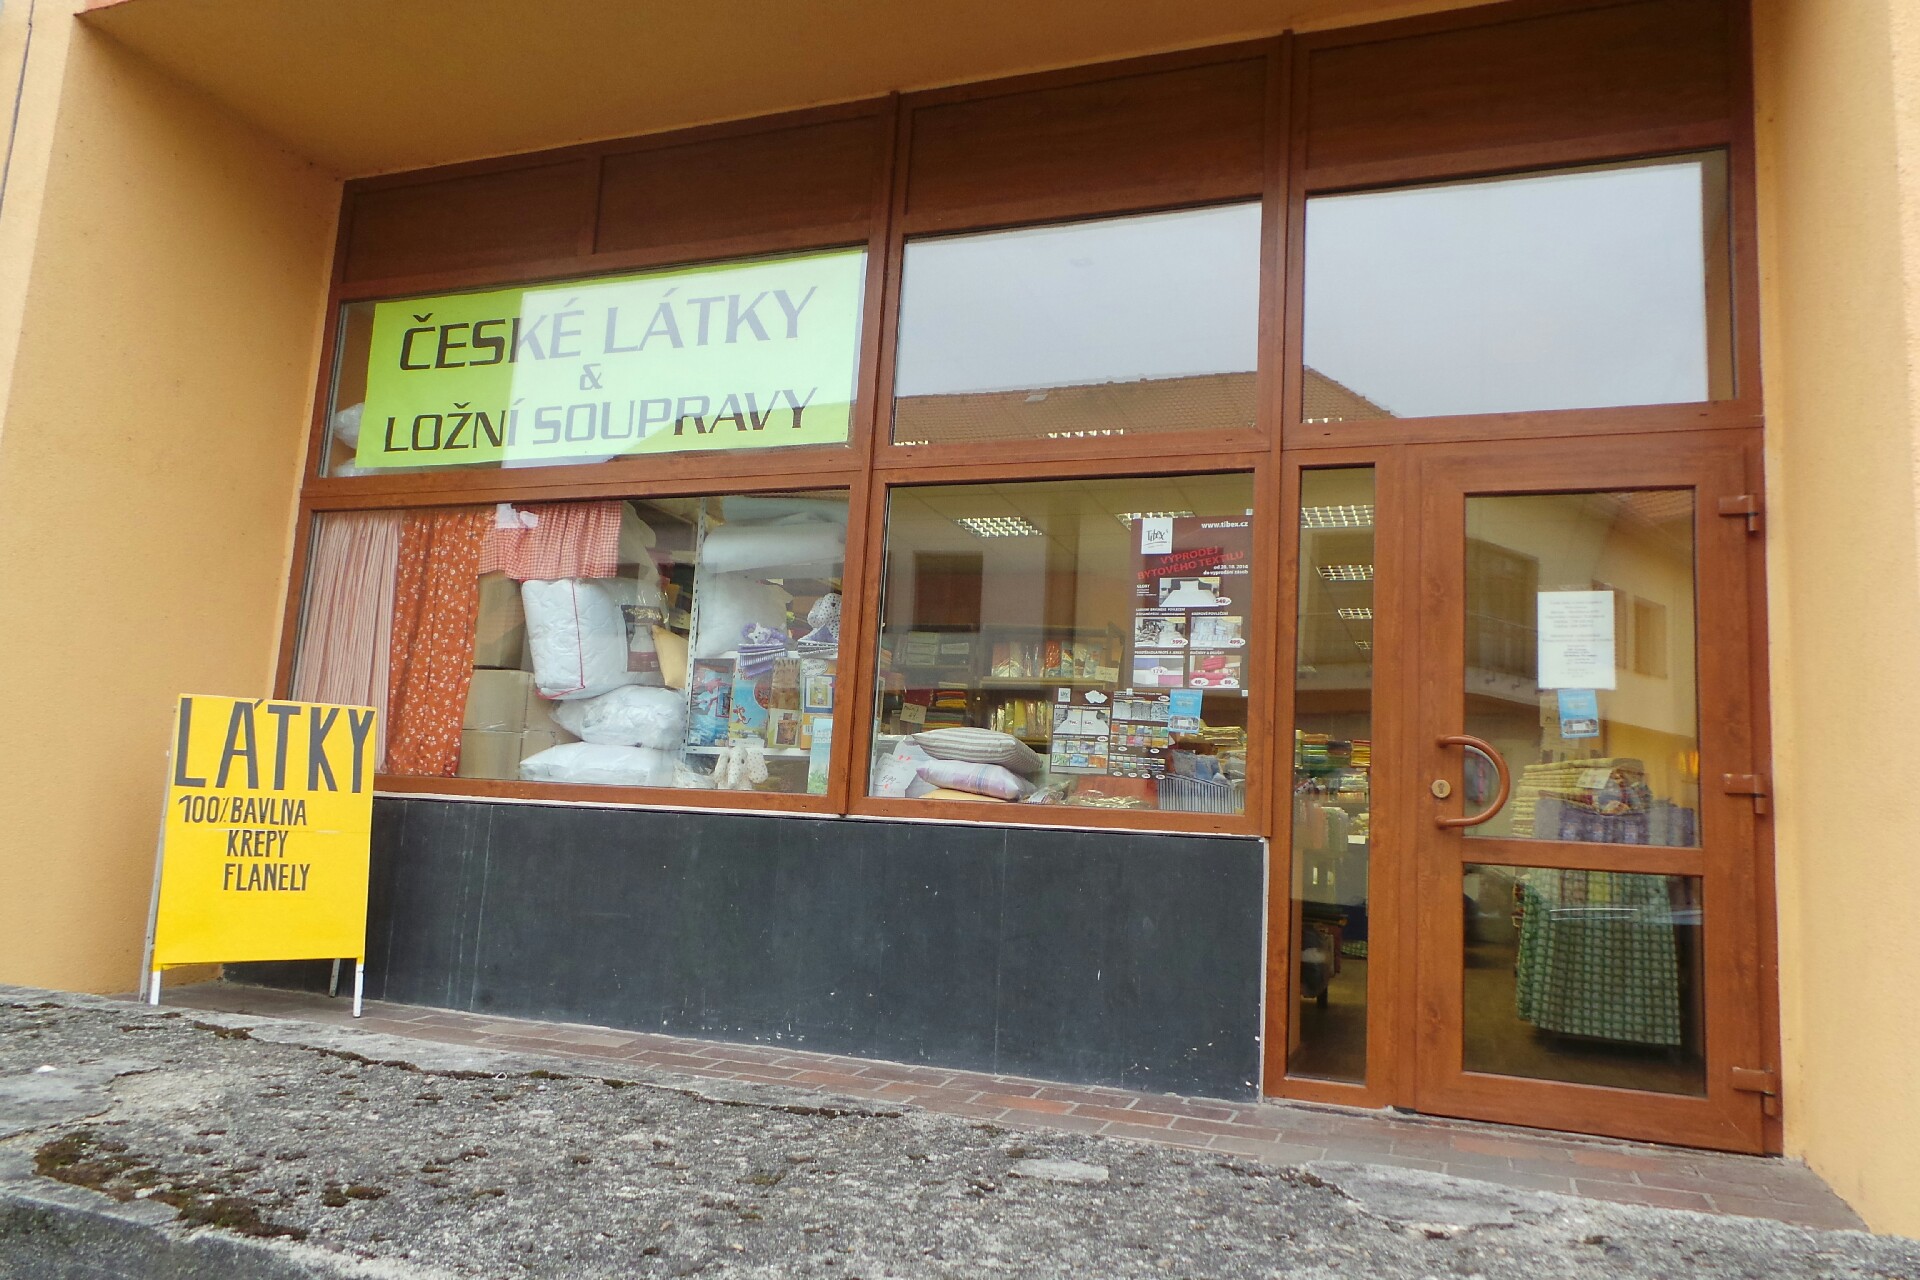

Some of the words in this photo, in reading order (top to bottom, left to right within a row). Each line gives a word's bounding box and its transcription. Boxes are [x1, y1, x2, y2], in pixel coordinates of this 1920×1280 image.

[399, 297, 585, 371] ČESKÉ
[603, 285, 819, 354] LÁTKY
[579, 363, 604, 391] &
[383, 397, 526, 453] LOŽNÍ
[532, 387, 819, 446] SOUPRAVY
[1201, 521, 1249, 529] www.tibex.cz
[1136, 561, 1197, 580] BYTOVÉHO
[1199, 550, 1245, 567] TEXTILU
[174, 697, 376, 794] LÁTKY
[178, 794, 230, 824] 100%
[230, 796, 308, 826] BAVLNA
[226, 829, 289, 858] KREPY
[223, 863, 311, 892] FLANELY
